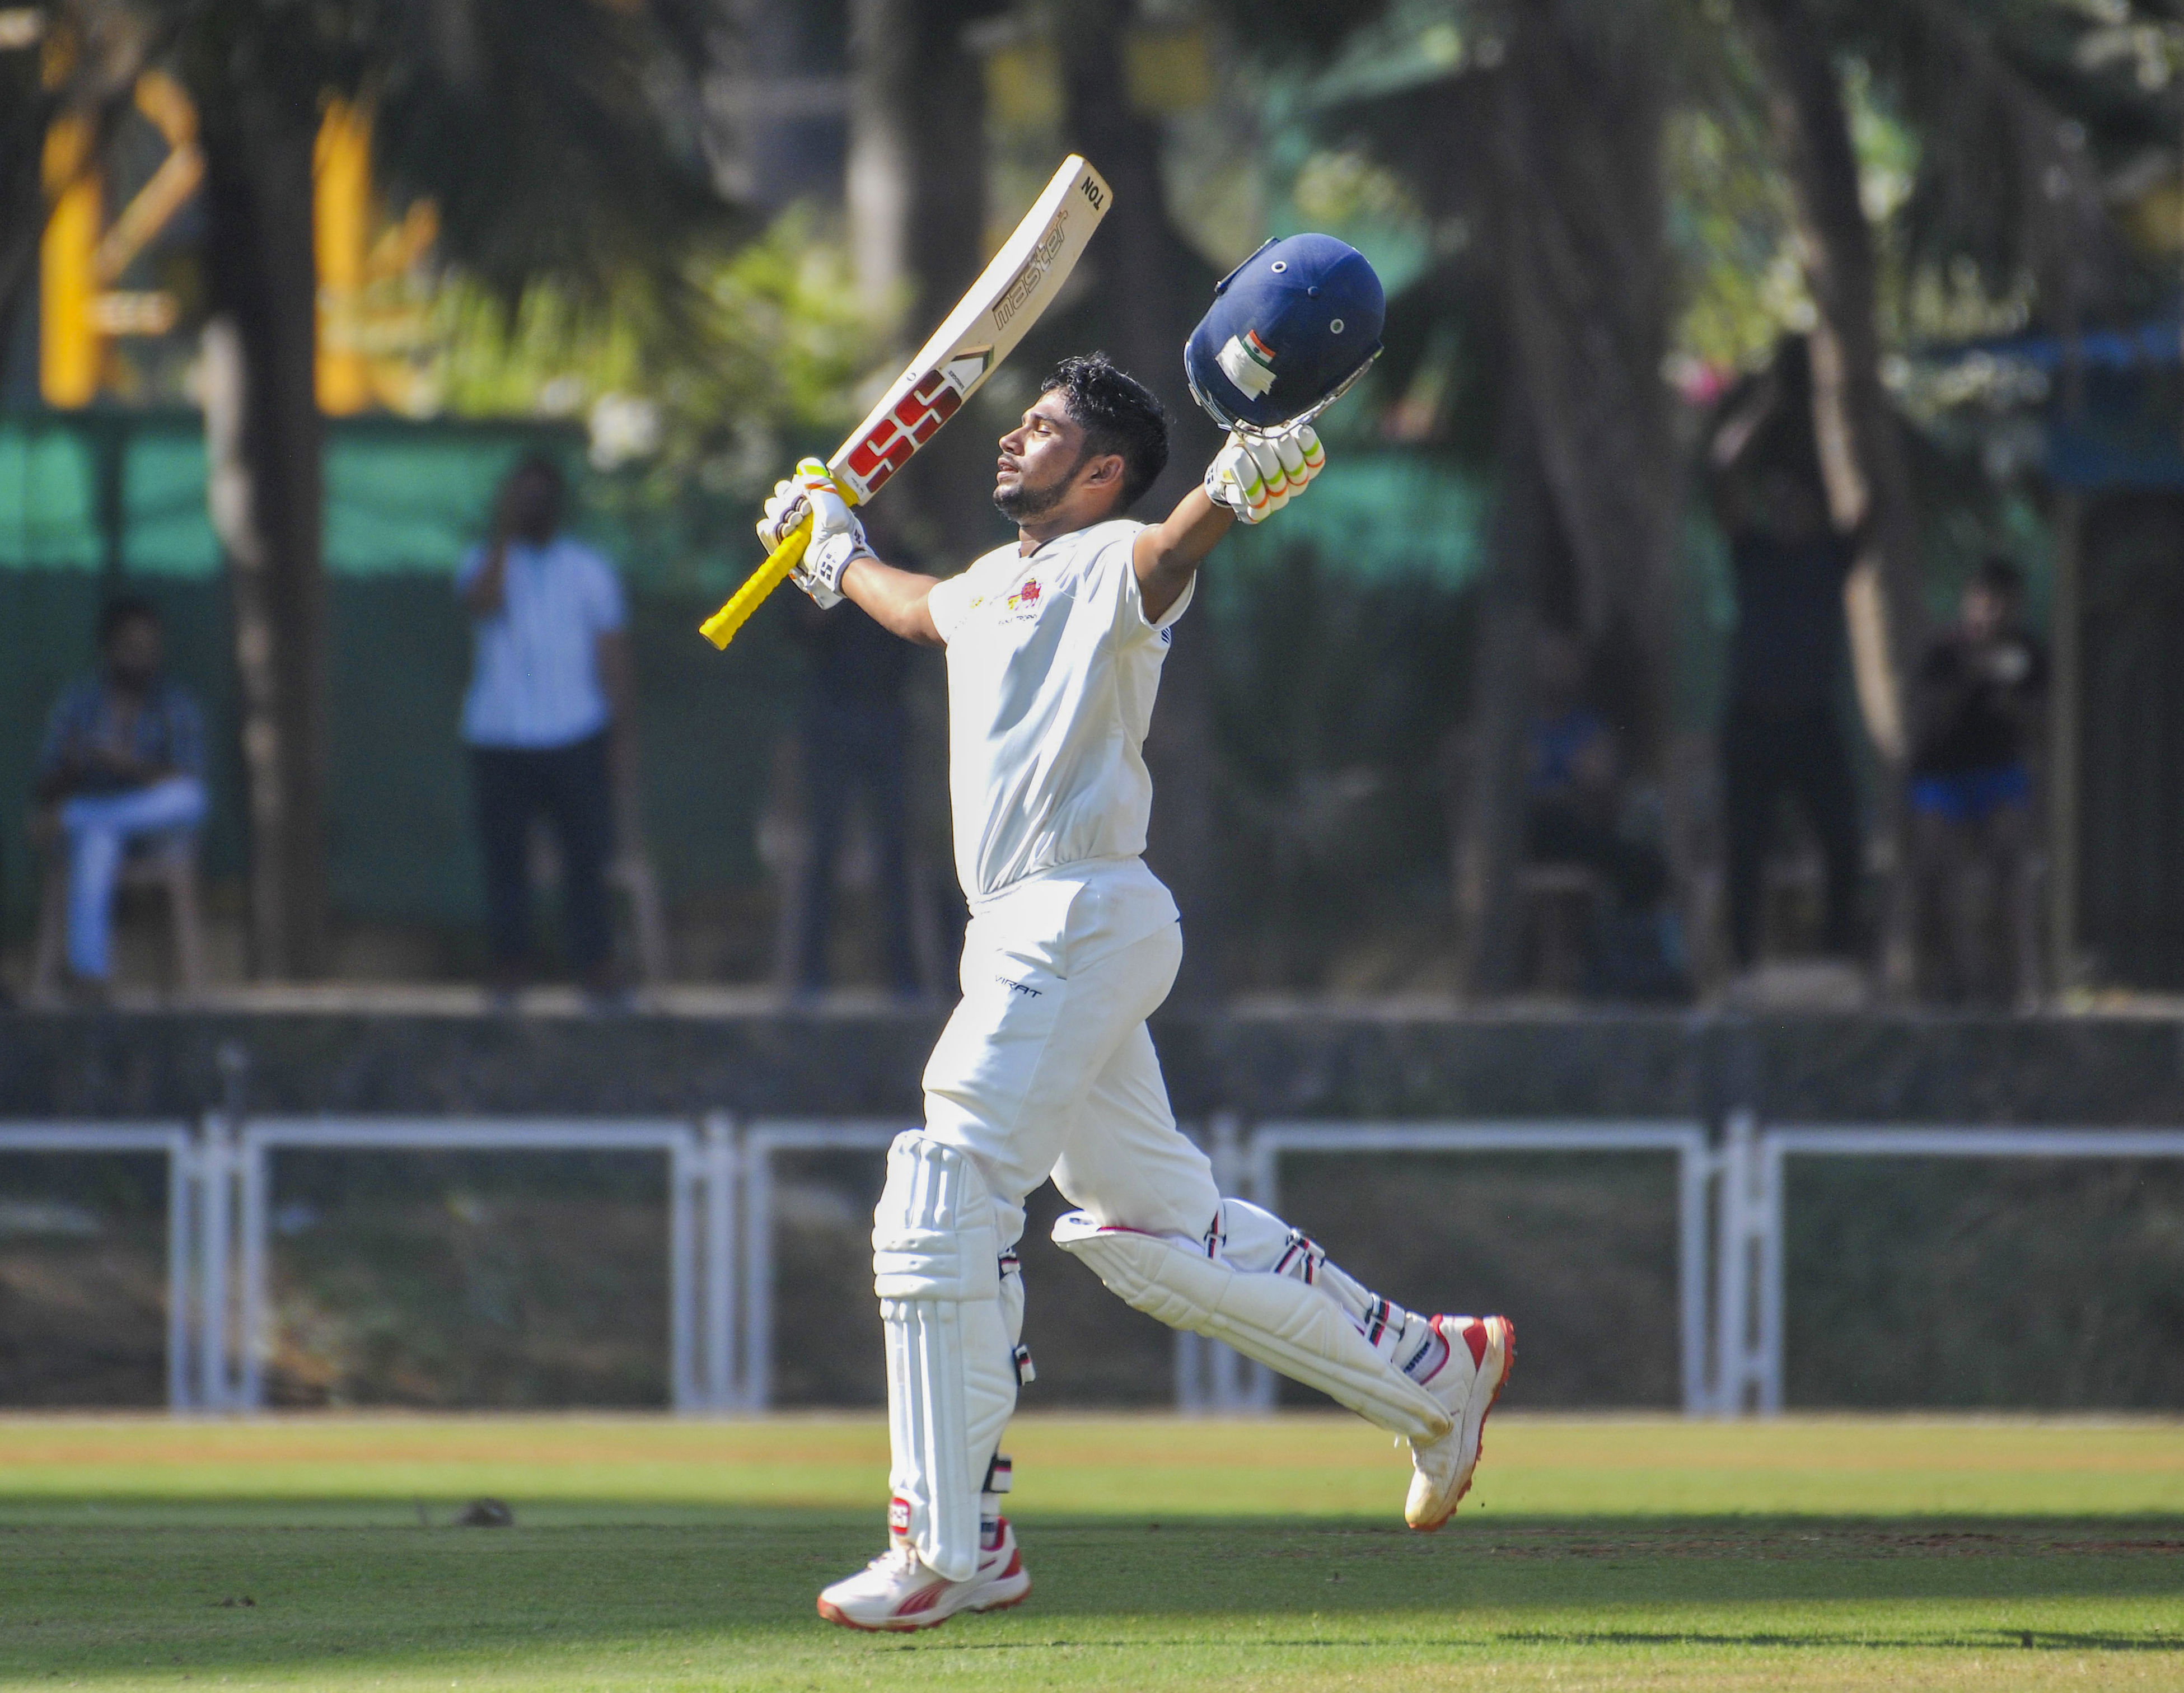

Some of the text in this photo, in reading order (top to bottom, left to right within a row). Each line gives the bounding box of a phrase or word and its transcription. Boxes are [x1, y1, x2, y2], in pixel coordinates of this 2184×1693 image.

[1081, 176, 1104, 211] TON
[992, 210, 1069, 331] master
[995, 975, 1042, 998] VIRAT
